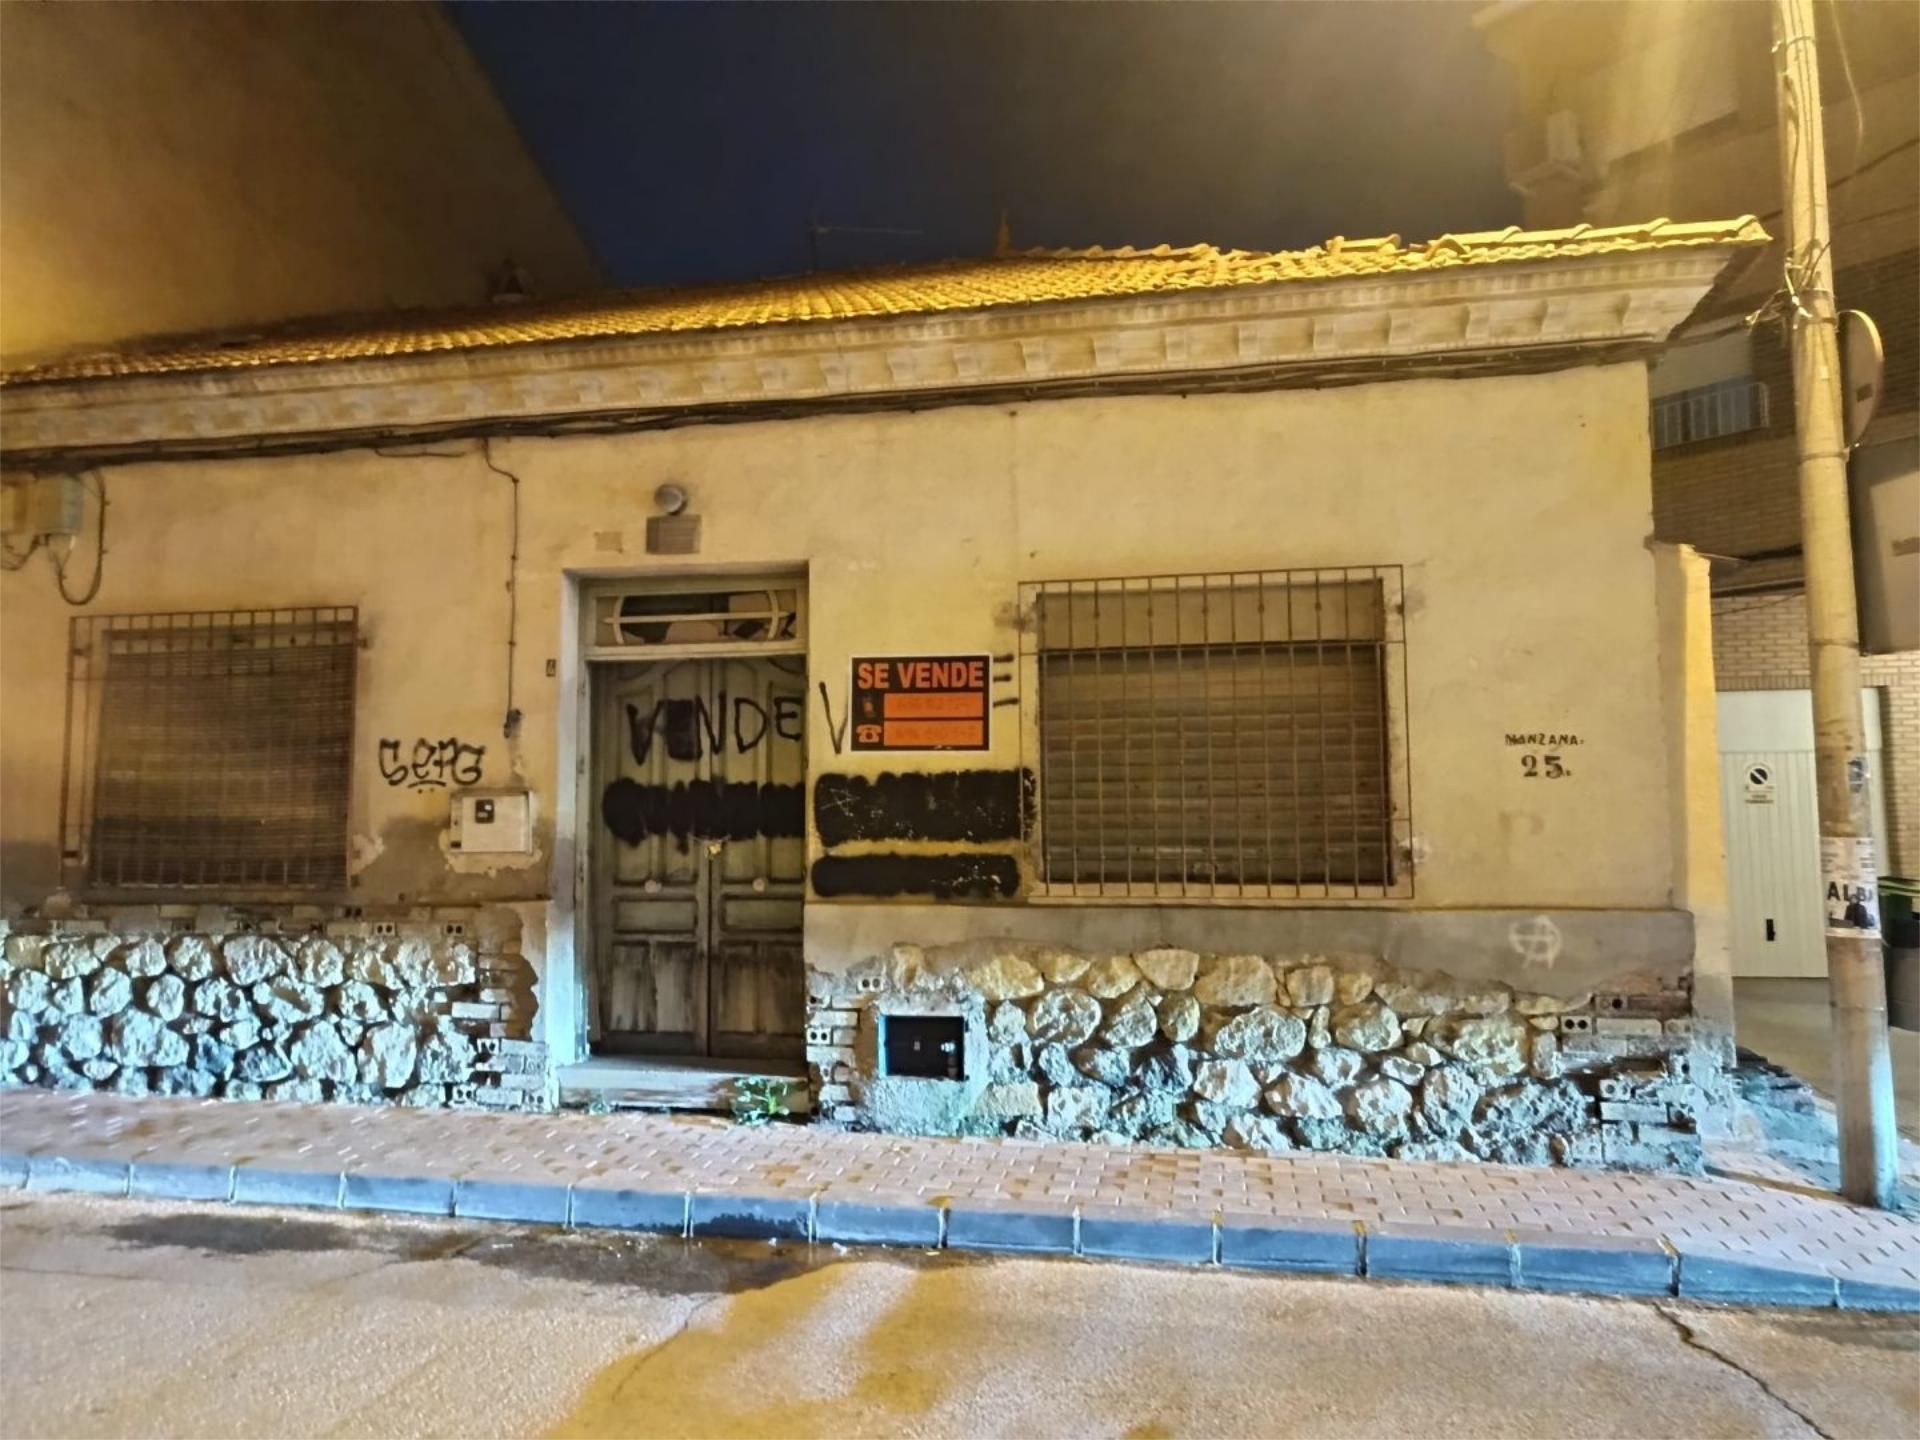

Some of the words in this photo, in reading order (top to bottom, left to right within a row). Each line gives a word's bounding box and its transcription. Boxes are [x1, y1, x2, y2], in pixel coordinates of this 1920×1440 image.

[857, 663, 890, 690] SE
[896, 661, 984, 690] VENDE
[626, 688, 803, 766] VNDE
[1521, 754, 1572, 779] 25.
